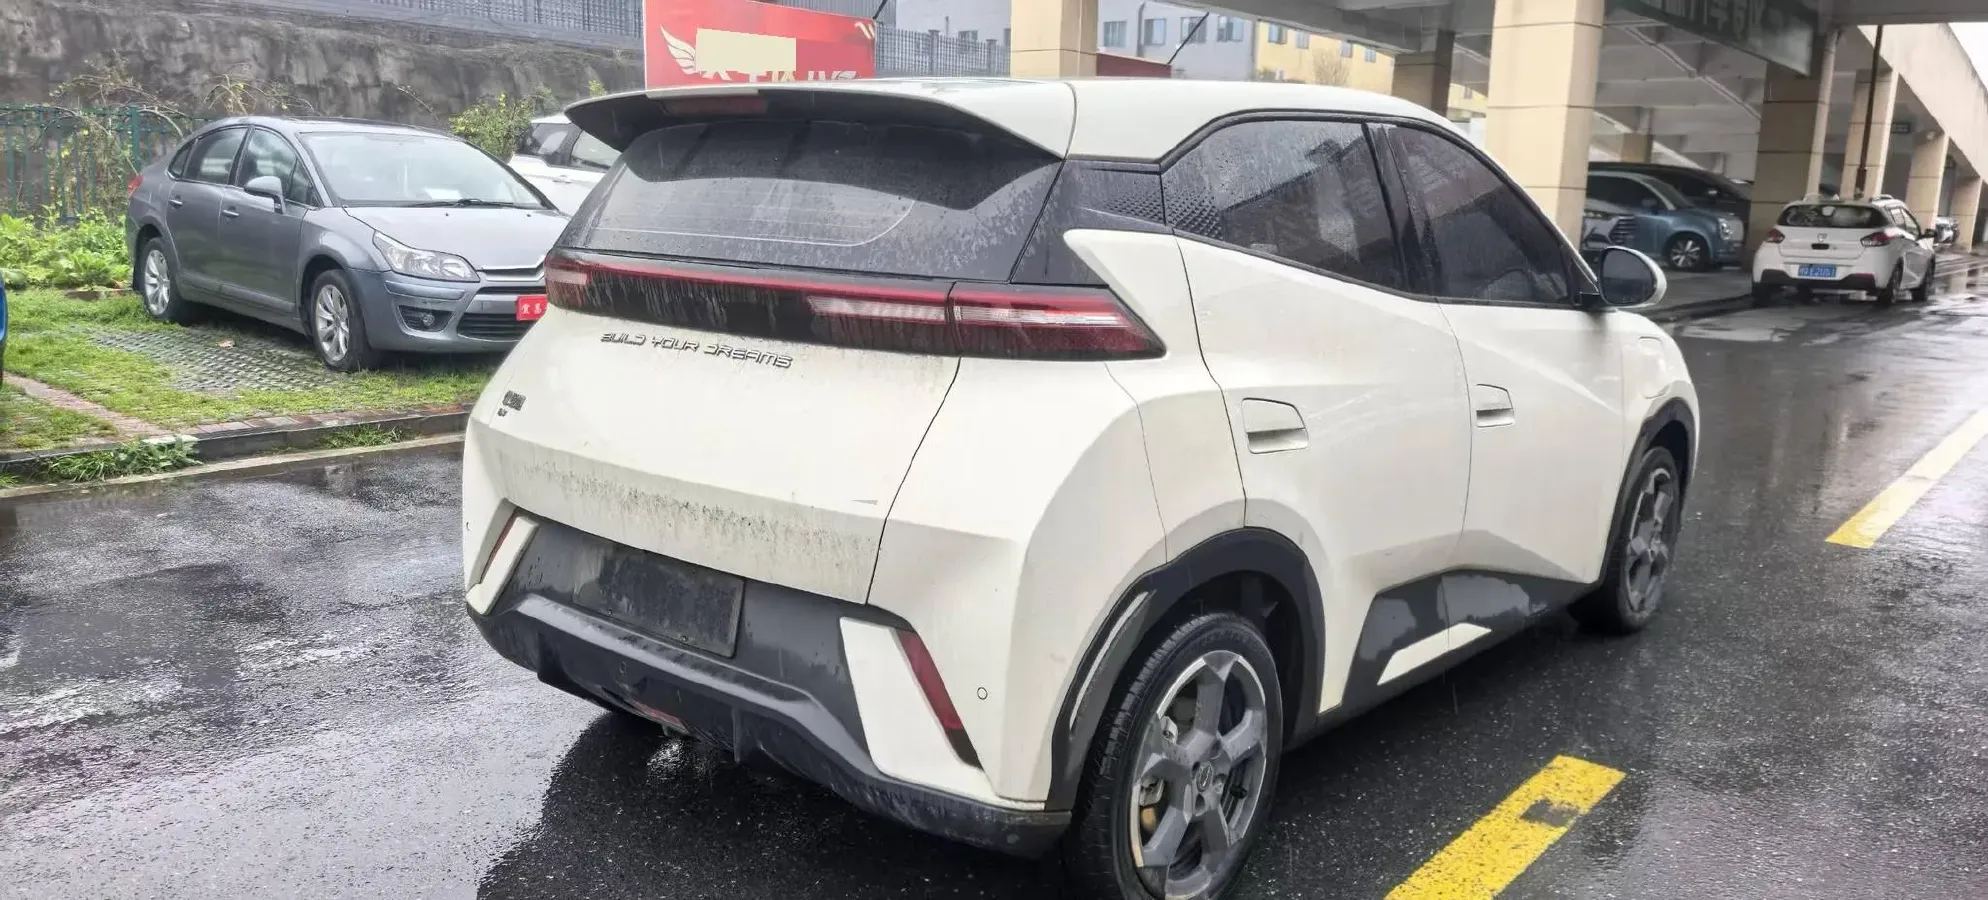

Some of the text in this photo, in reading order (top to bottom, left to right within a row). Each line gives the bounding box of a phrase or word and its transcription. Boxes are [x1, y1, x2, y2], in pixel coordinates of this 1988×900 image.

[600, 331, 793, 369] BUILD YOUR DREAMS
